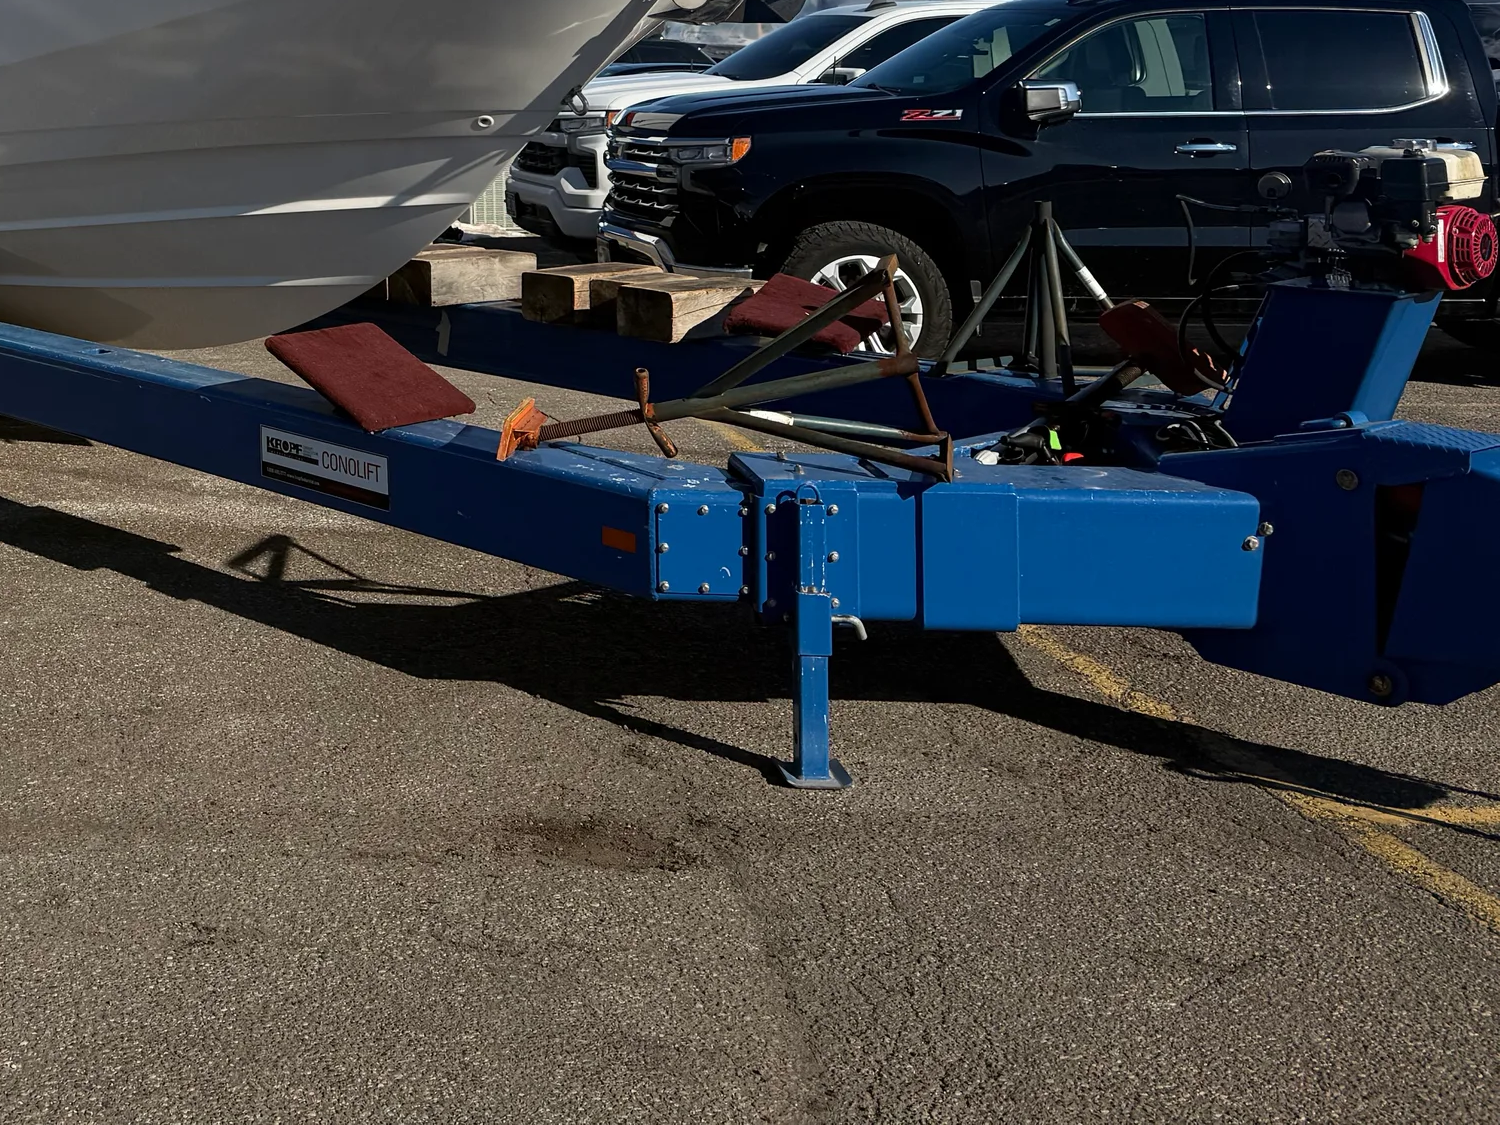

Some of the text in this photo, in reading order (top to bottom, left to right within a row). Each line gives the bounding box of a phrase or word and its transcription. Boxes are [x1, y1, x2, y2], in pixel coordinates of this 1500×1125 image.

[900, 109, 964, 121] Z71
[266, 436, 303, 455] KROPF
[321, 451, 382, 483] CONOLIFT
